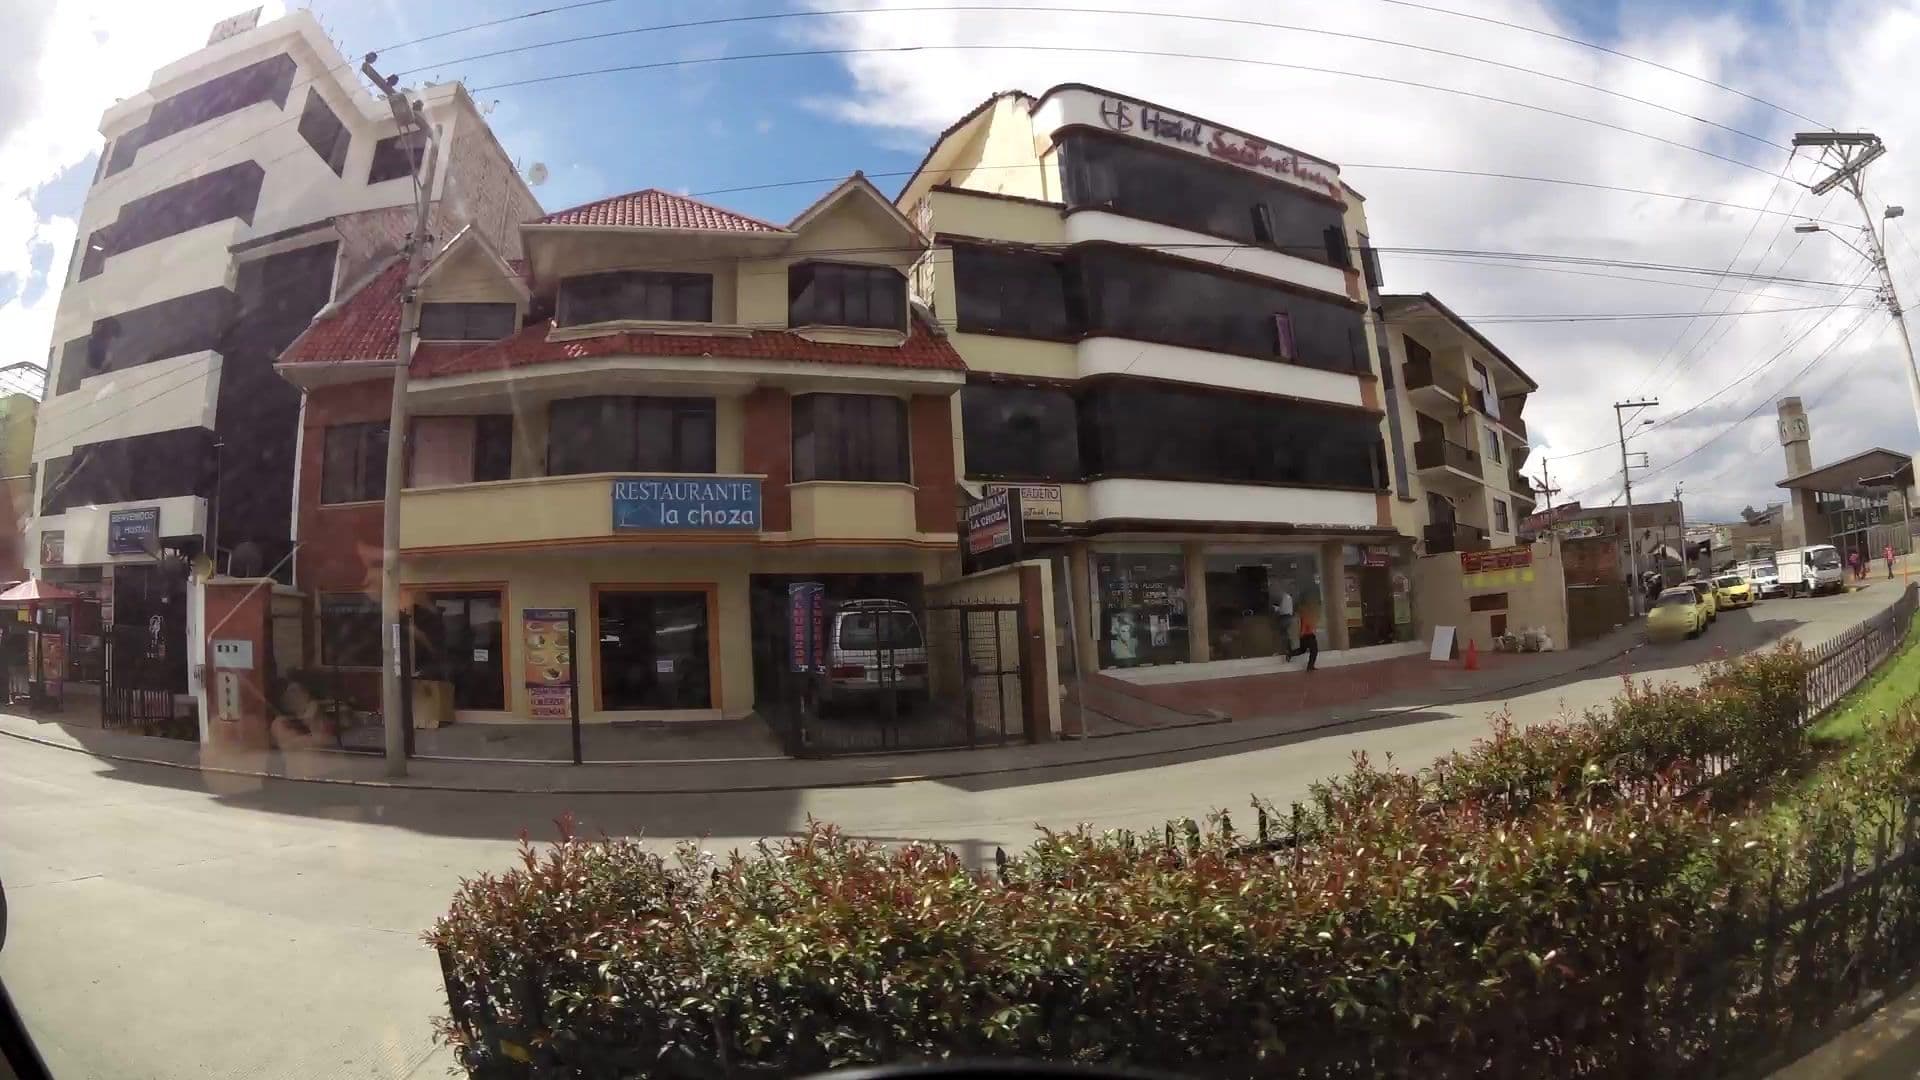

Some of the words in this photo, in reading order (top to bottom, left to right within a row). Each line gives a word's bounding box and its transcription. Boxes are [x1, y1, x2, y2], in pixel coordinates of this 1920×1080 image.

[615, 481, 752, 501] RESTAURANTE
[660, 503, 679, 525] la
[687, 503, 754, 526] choza
[971, 517, 980, 531] LA
[981, 510, 1007, 528] CHOZA
